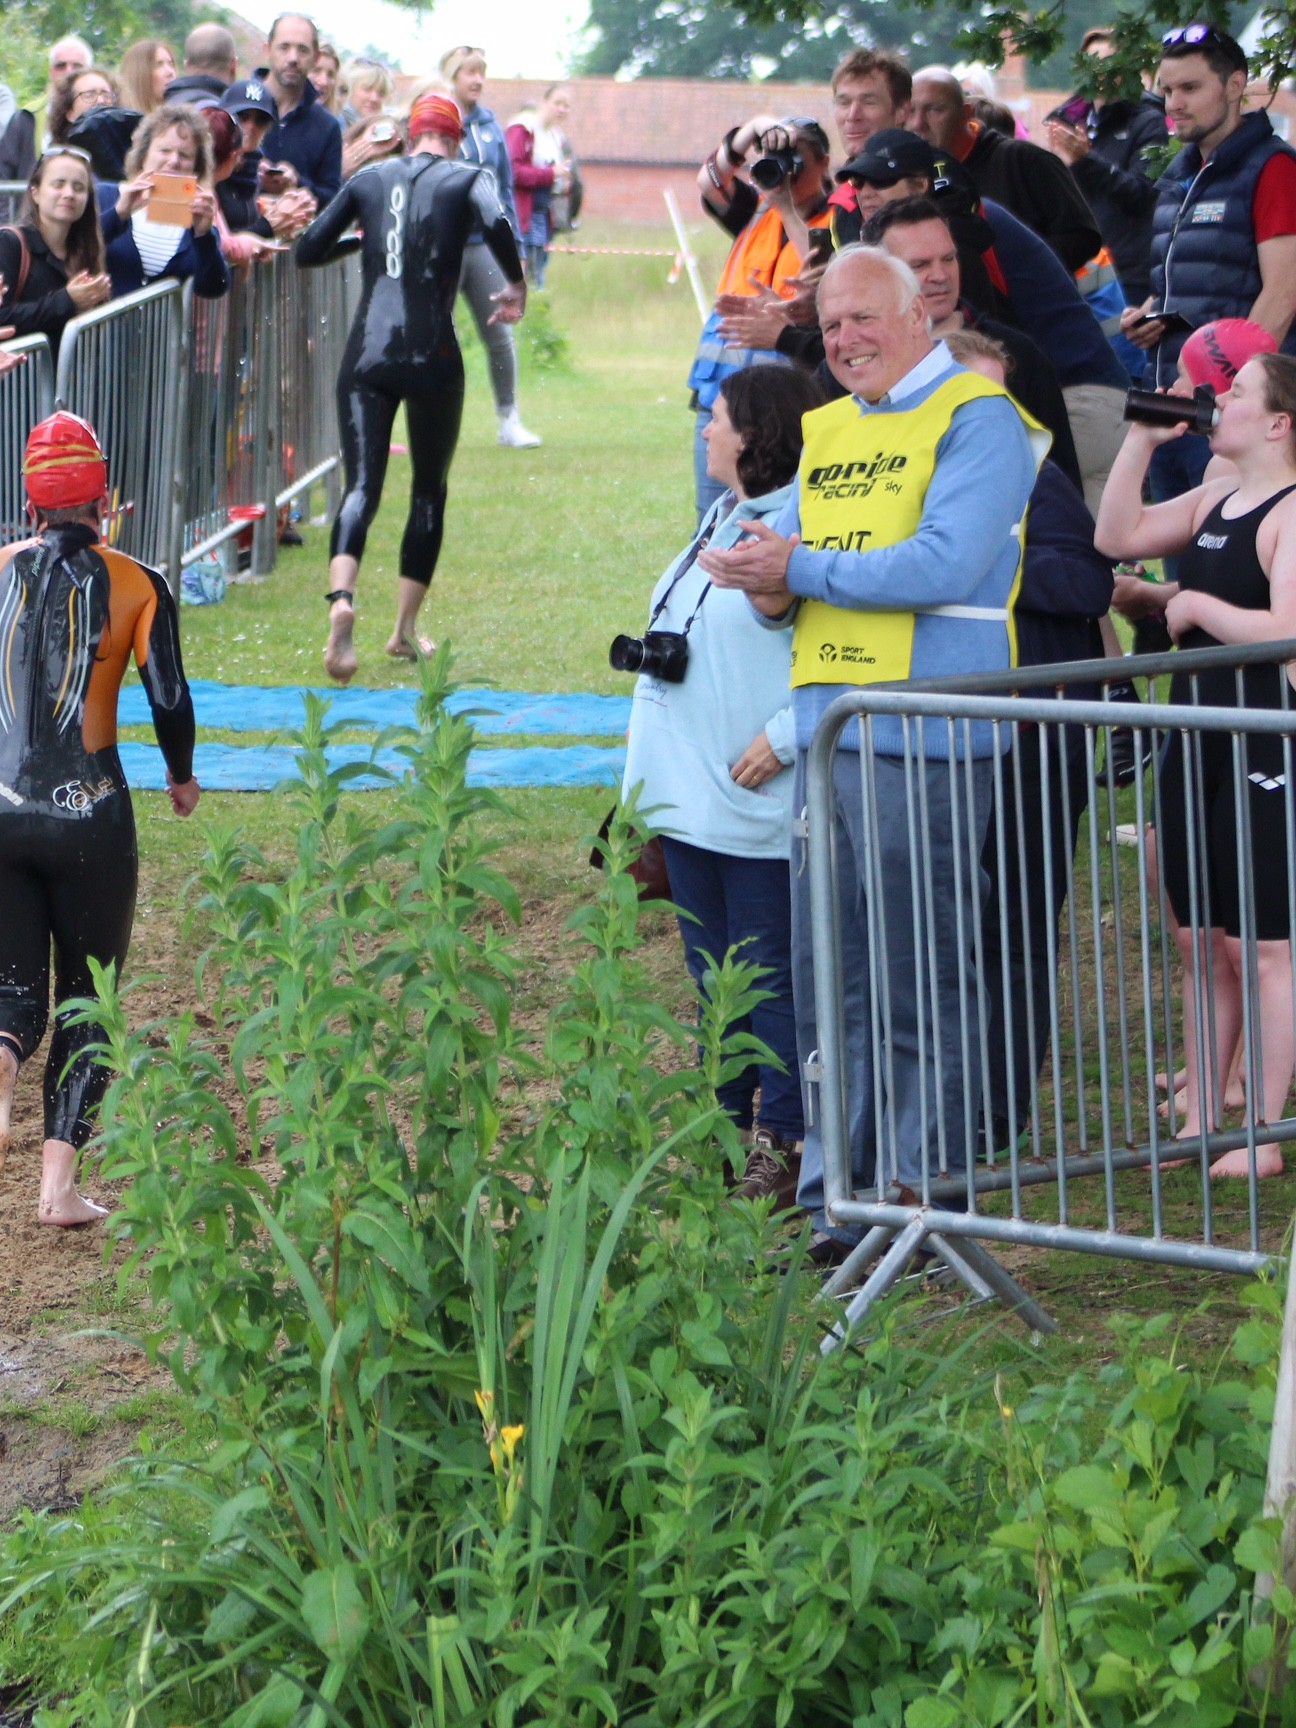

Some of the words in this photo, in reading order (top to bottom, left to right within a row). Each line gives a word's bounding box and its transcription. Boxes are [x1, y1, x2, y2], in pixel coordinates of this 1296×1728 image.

[386, 185, 404, 279] orca
[884, 481, 902, 496] sky
[1197, 532, 1228, 549] arena
[841, 646, 864, 655] SPORT
[841, 654, 876, 664] ENGLAND
